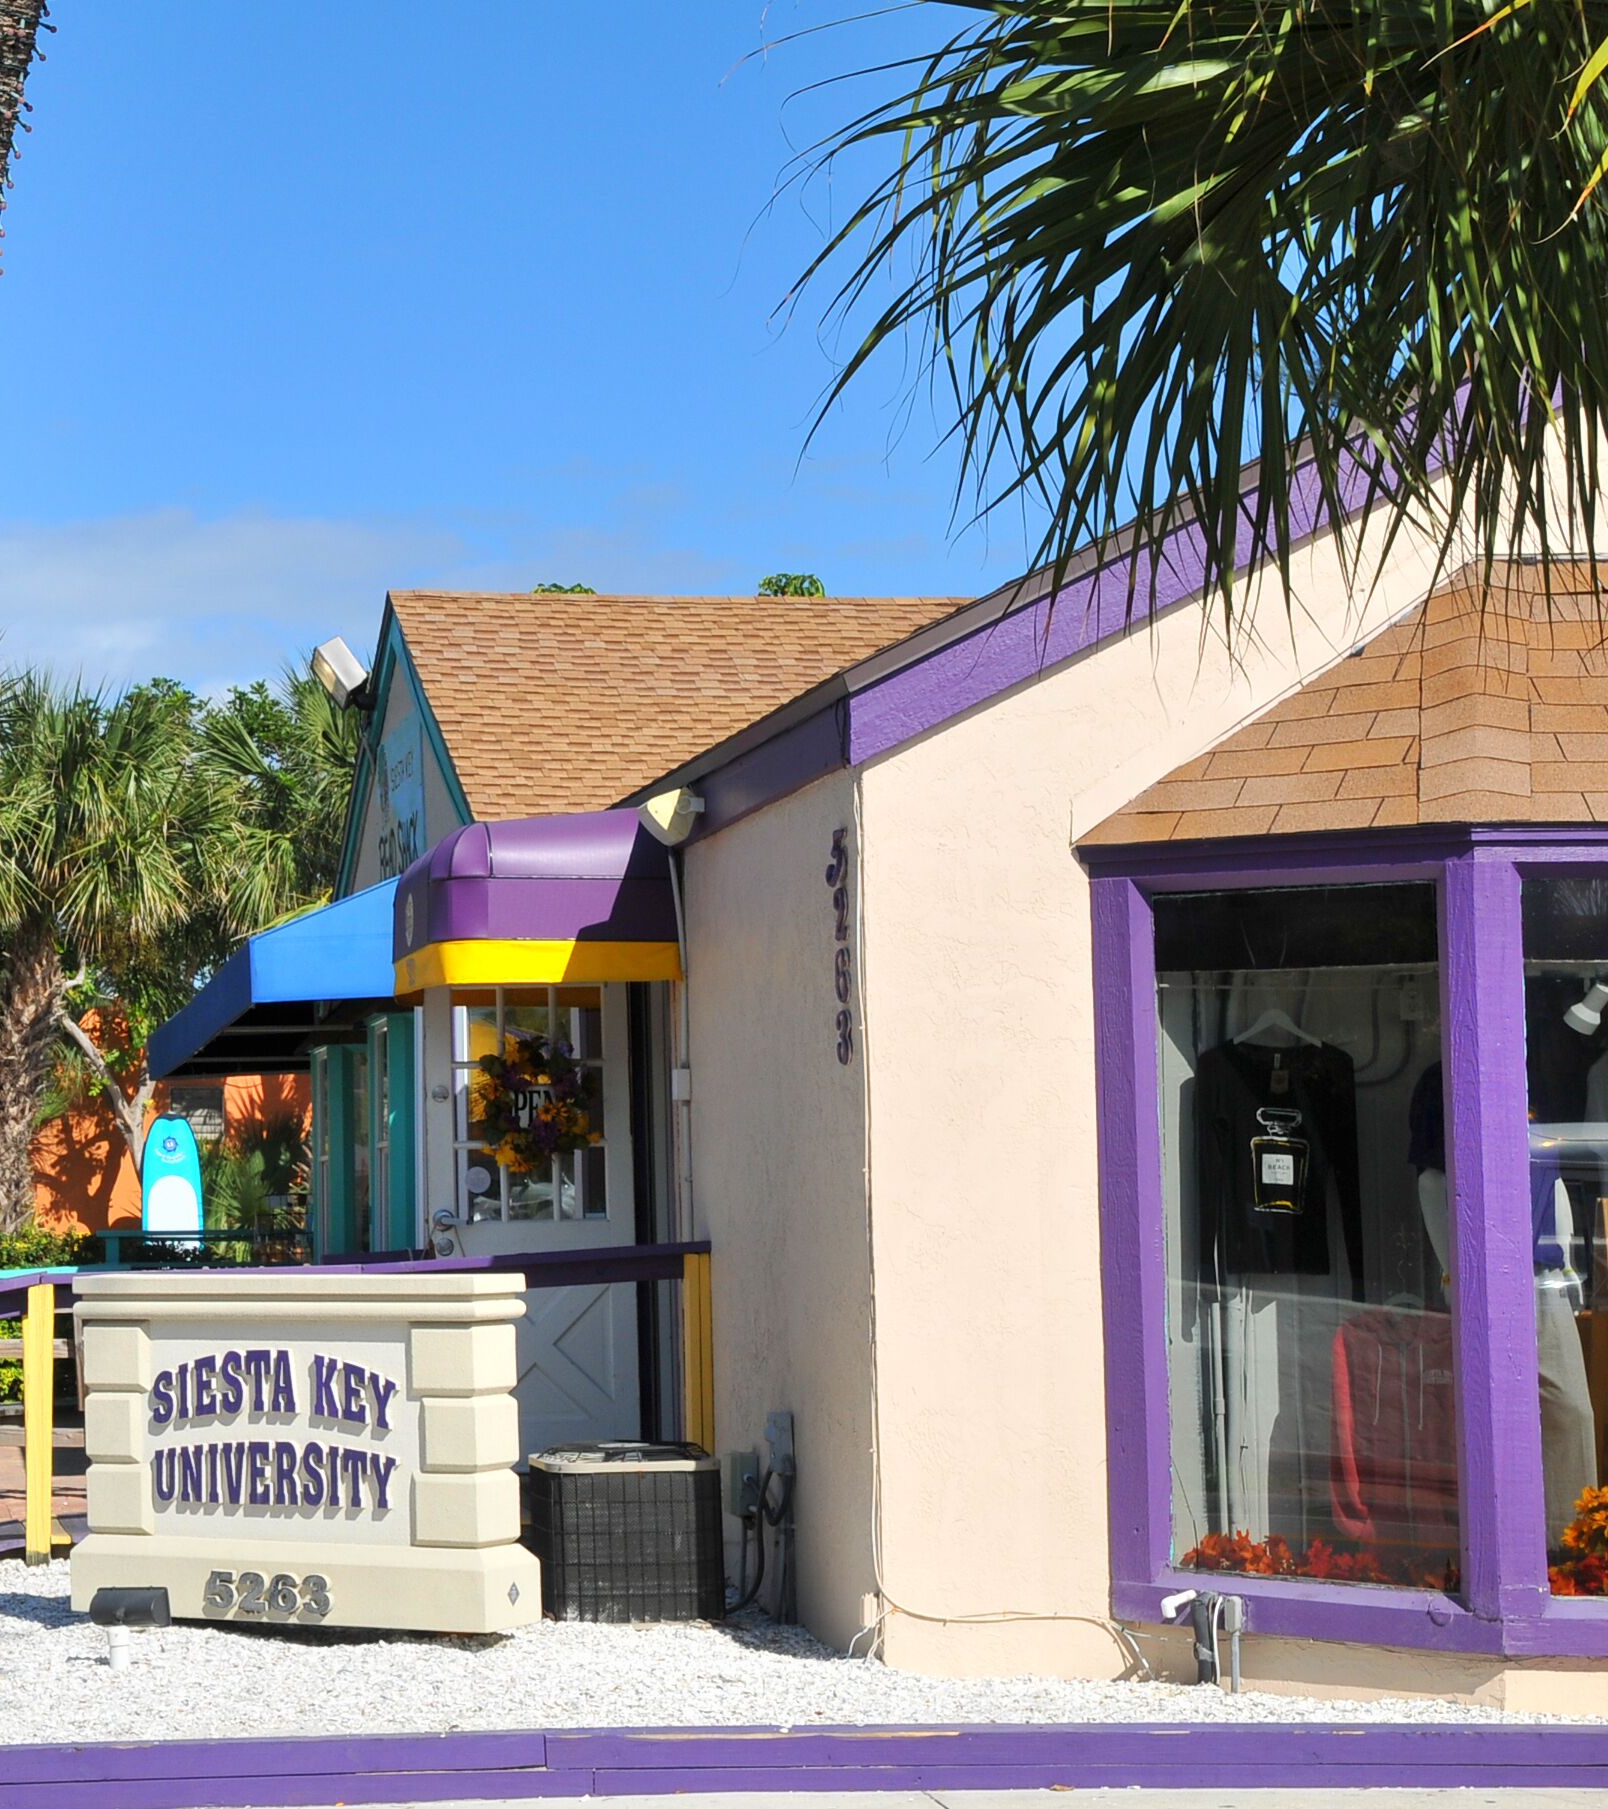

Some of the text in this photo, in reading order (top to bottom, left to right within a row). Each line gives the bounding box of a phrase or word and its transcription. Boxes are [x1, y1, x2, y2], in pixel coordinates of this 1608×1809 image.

[826, 828, 853, 1065] 5263
[153, 1349, 397, 1430] SIESTA KEY
[154, 1441, 398, 1509] UNIVERSITY
[203, 1569, 331, 1615] 5263
